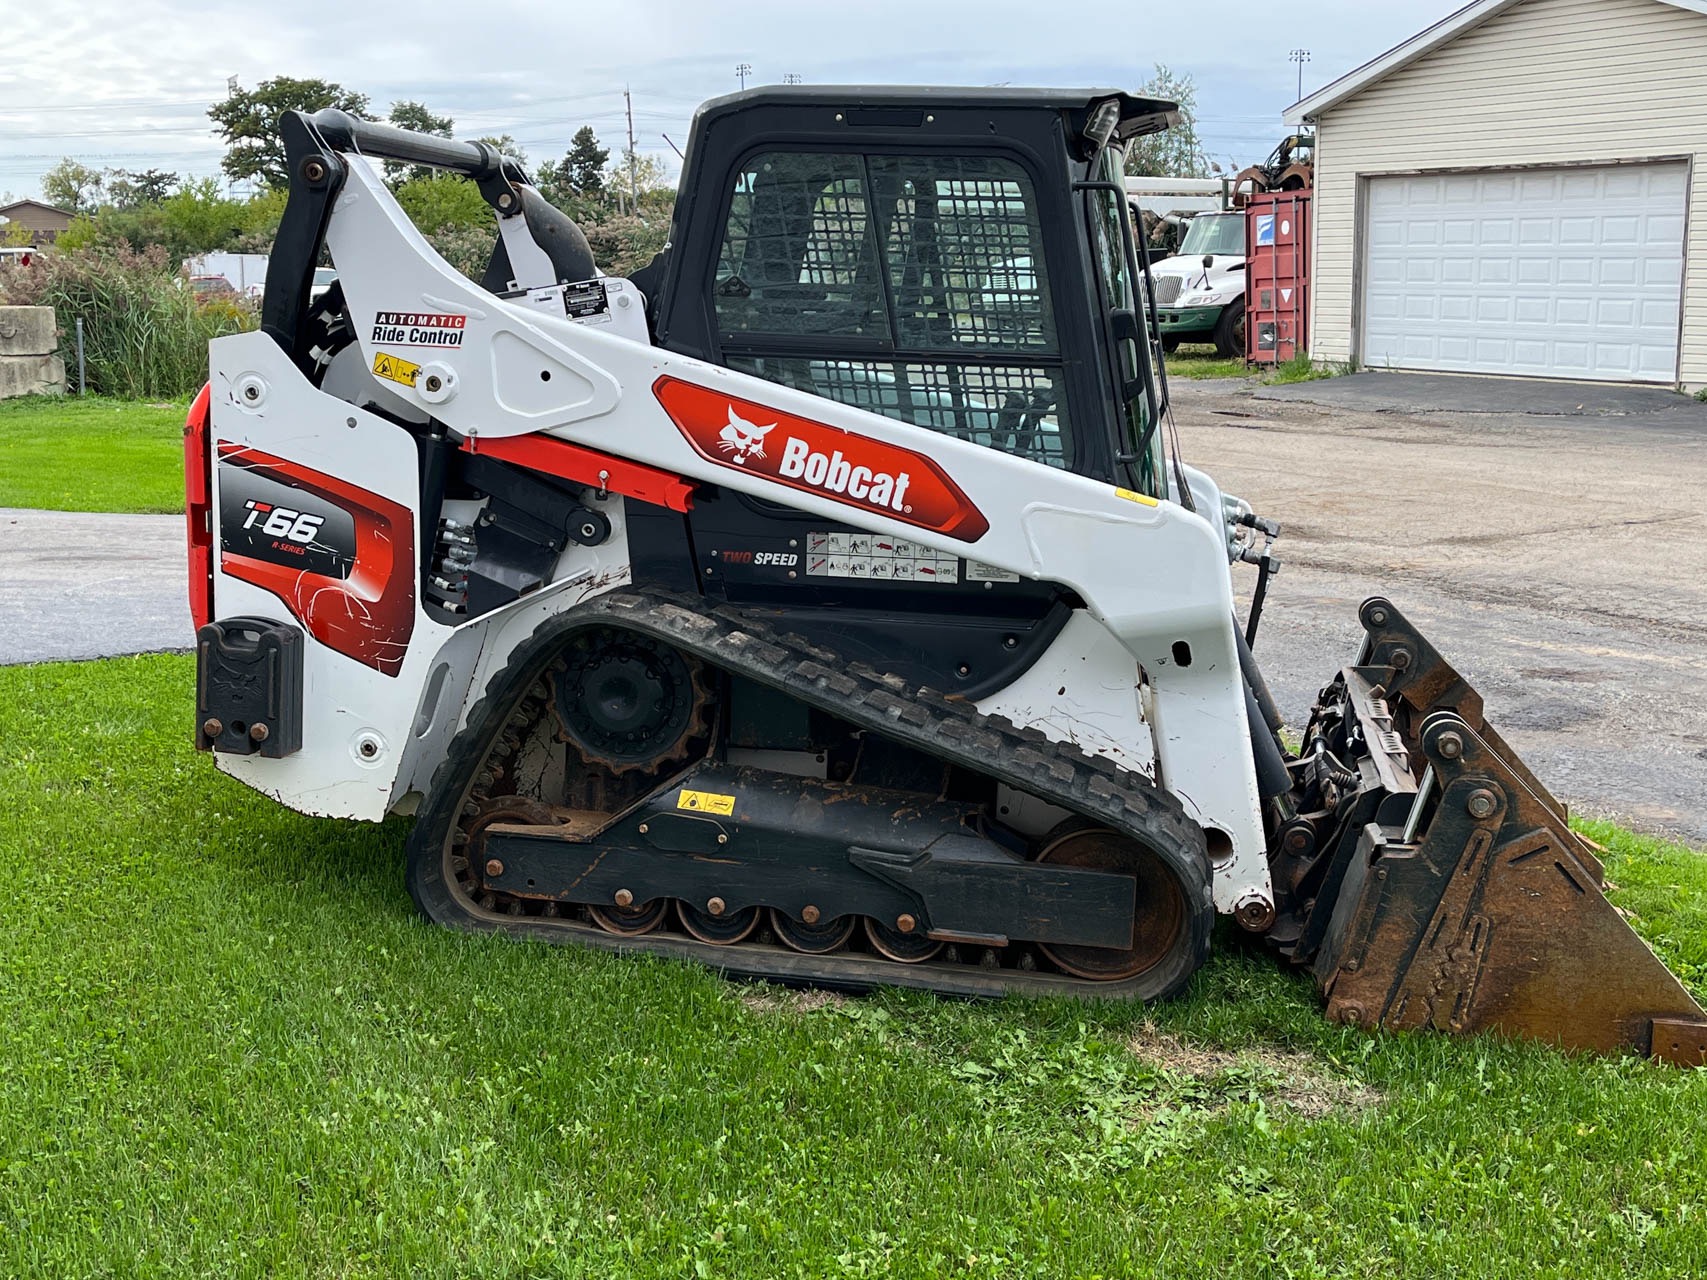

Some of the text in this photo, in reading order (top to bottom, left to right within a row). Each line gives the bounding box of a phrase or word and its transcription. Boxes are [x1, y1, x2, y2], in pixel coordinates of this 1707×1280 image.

[378, 313, 463, 328] AUTOMATIC
[371, 326, 464, 345] Ride Control
[779, 436, 910, 512] Bobcat
[242, 500, 325, 544] T66
[271, 541, 306, 556] R-SERIES
[722, 551, 799, 567] TWO SPEED
